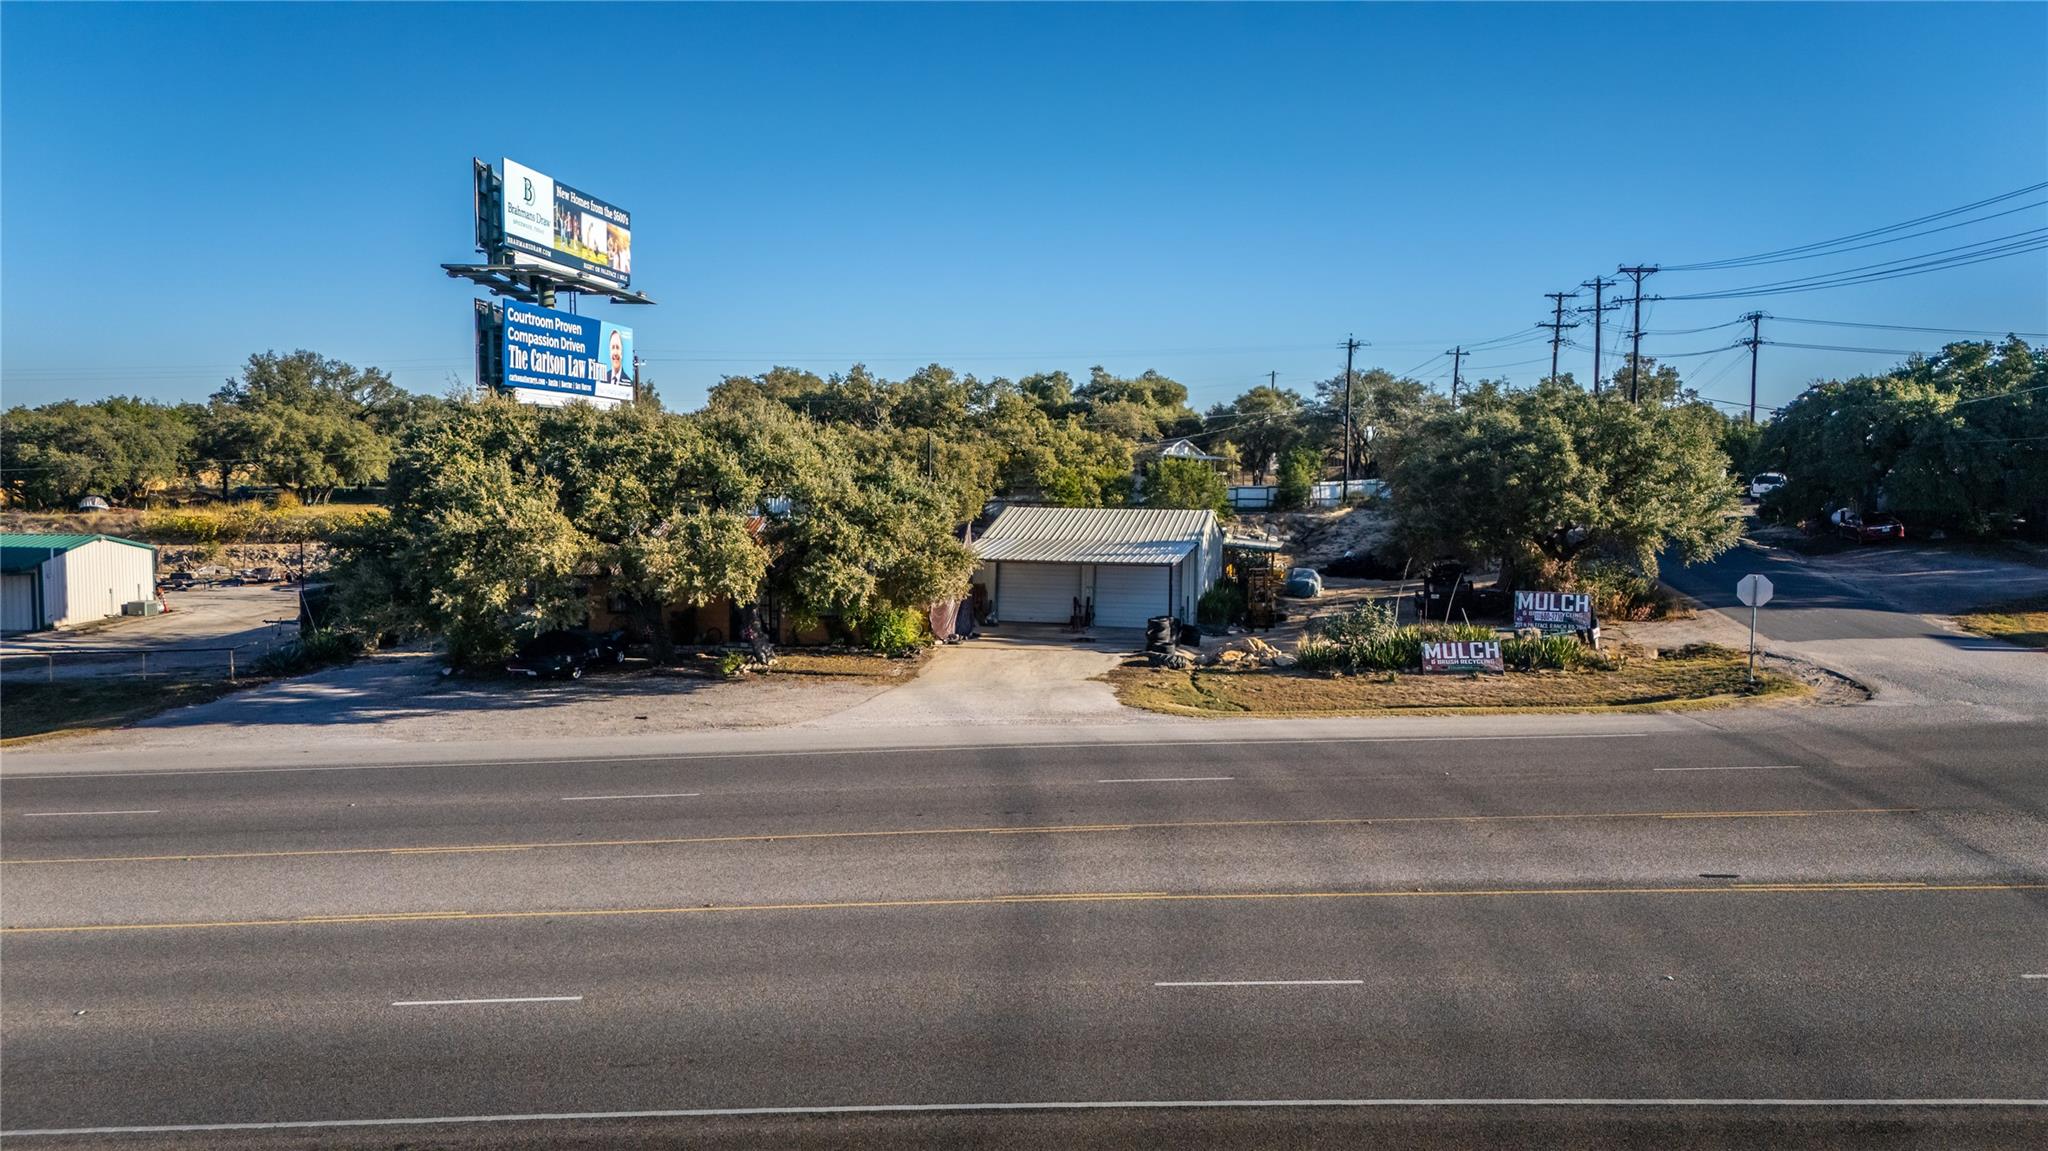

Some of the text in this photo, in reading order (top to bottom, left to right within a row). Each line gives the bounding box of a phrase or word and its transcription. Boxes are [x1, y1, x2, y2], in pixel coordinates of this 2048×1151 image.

[508, 202, 551, 227] Brahmans Draw
[556, 185, 570, 201] New
[570, 191, 590, 209] Homes
[590, 200, 603, 215] from
[603, 206, 613, 219] the
[507, 307, 582, 335] Courtroom Proven
[507, 327, 586, 353] Compassion Driven
[508, 344, 608, 381] The Carlson Law Firm
[1518, 592, 1589, 612] MULCH
[1424, 642, 1500, 659] MULCH
